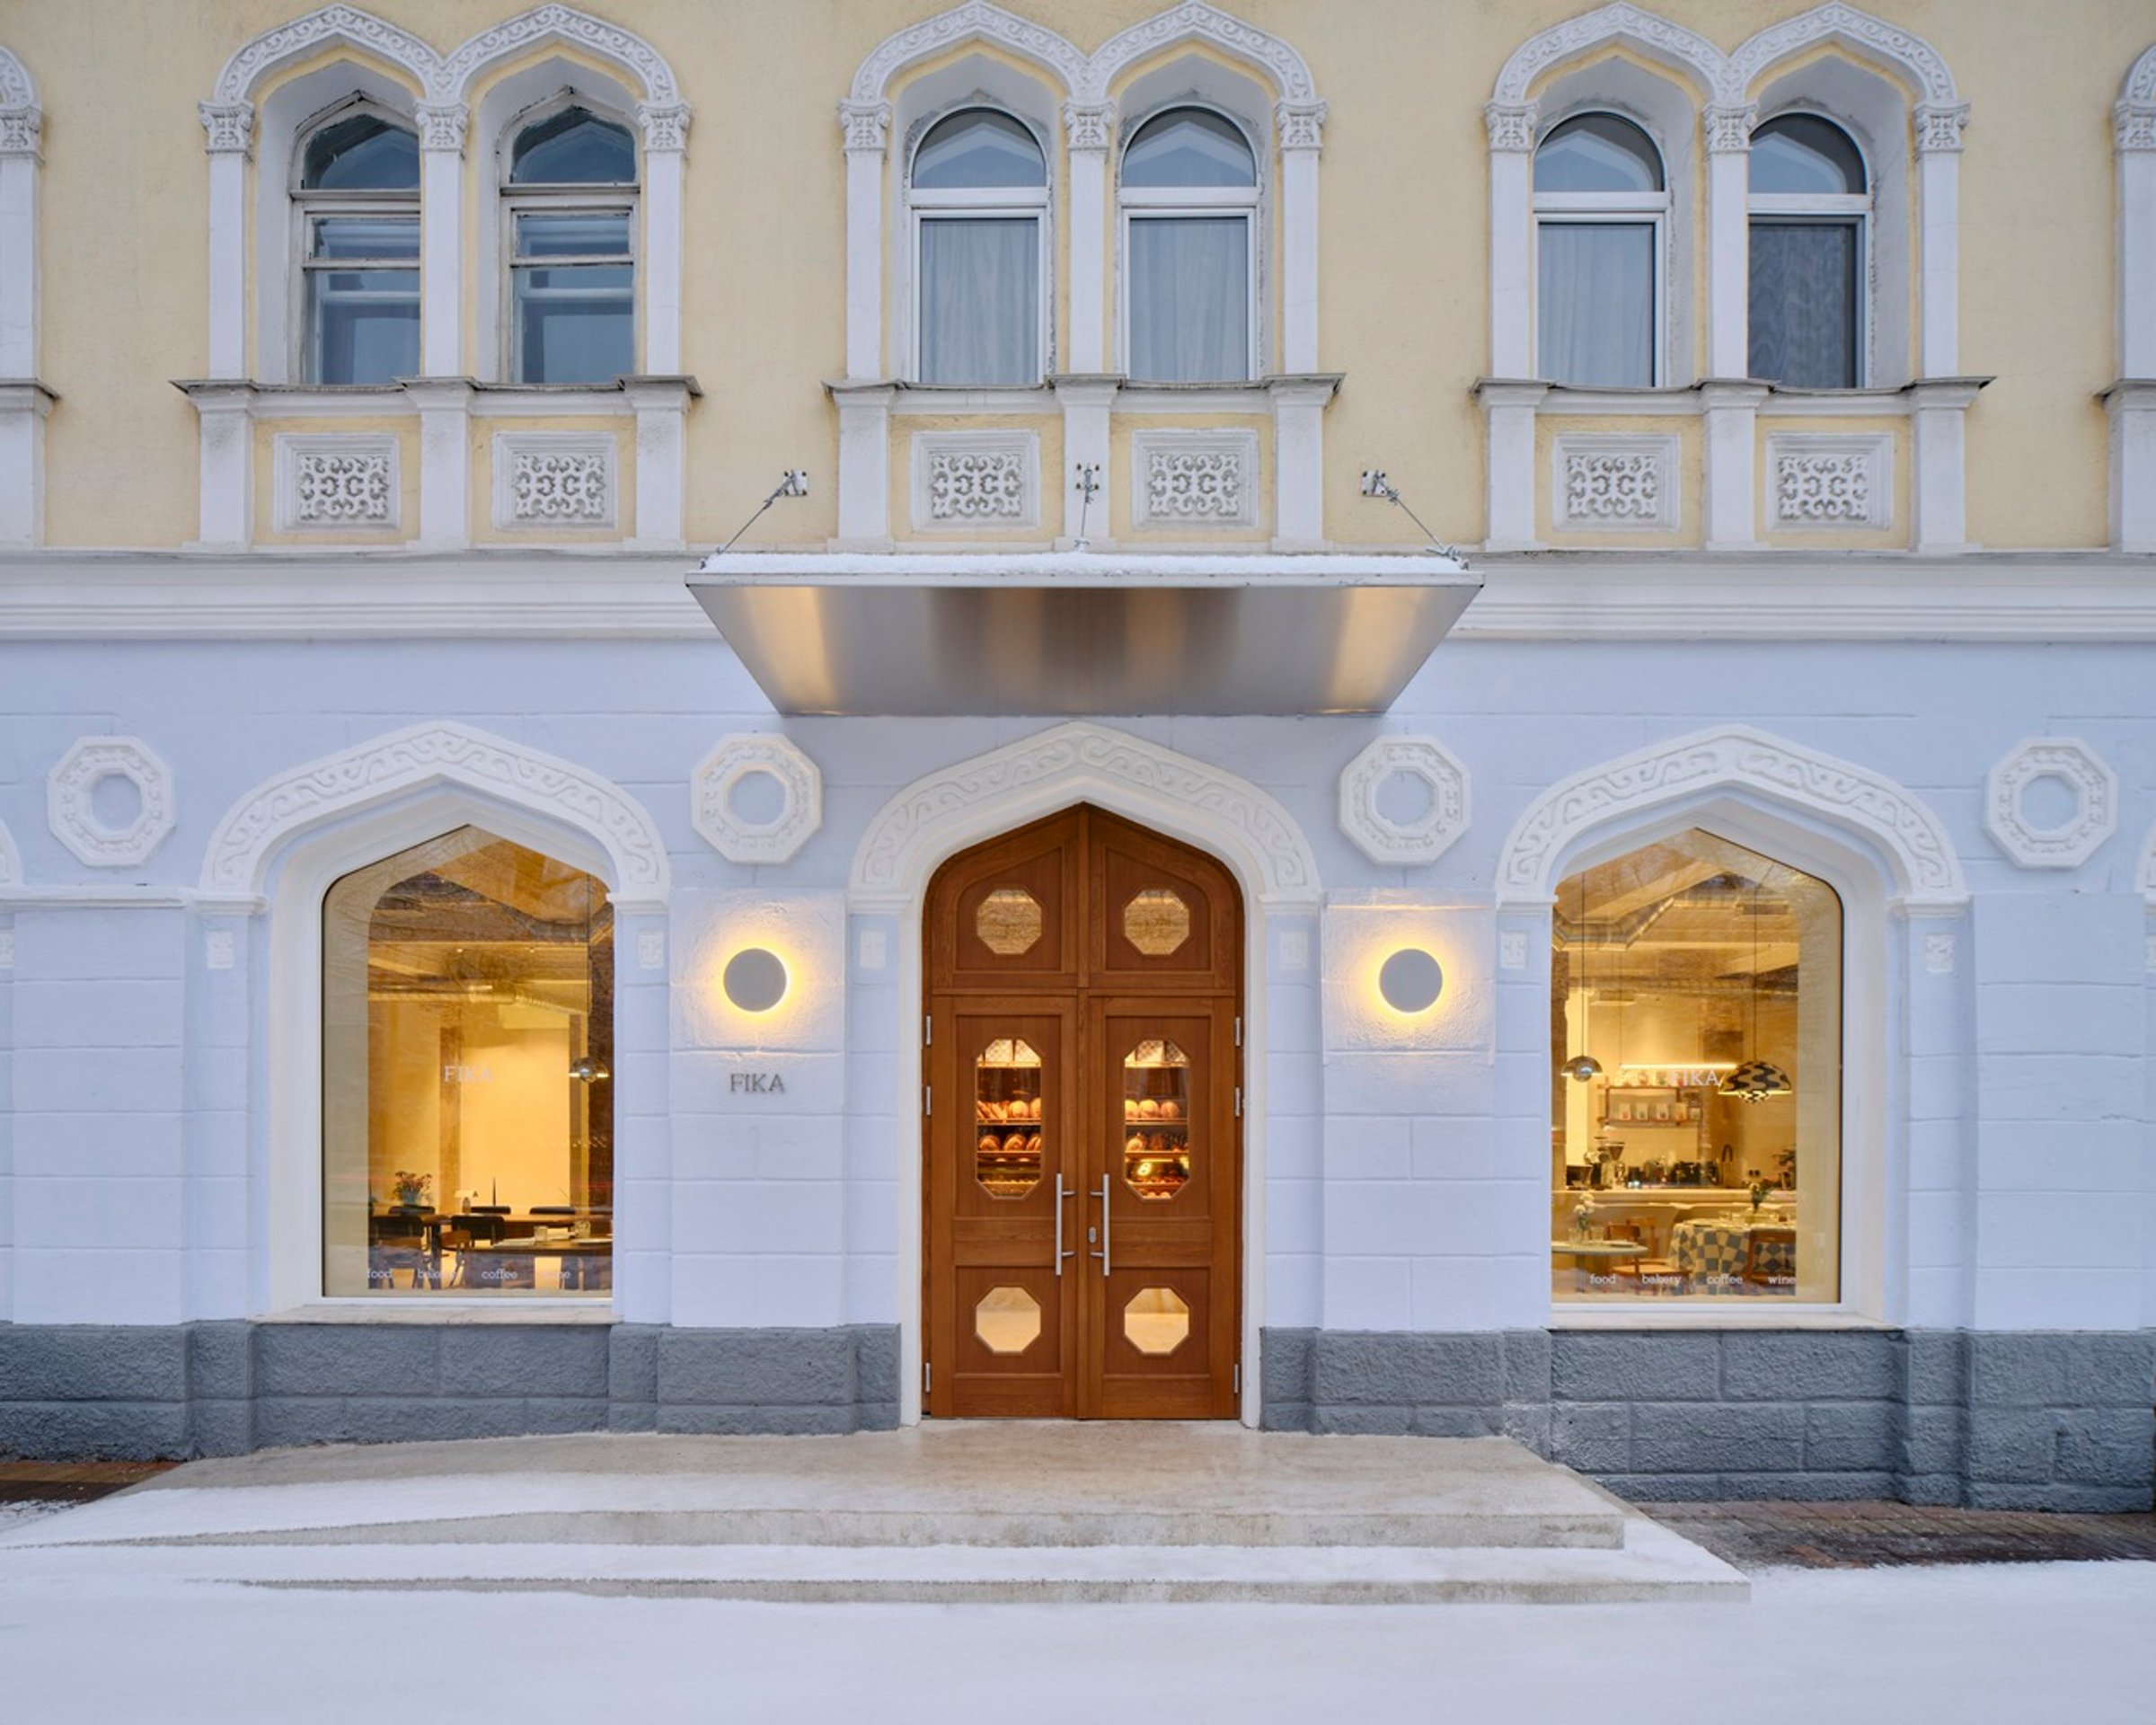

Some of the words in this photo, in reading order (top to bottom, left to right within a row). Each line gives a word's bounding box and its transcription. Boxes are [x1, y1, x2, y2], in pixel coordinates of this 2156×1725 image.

[444, 1066, 493, 1084] FIKA
[730, 1073, 785, 1092] FIKA
[1669, 1068, 1720, 1086] FIKA
[481, 1268, 518, 1280] coffee
[1590, 1273, 1616, 1285] food
[1642, 1273, 1681, 1287] bakery
[1707, 1273, 1743, 1285] coffee
[1767, 1273, 1797, 1285] wine
